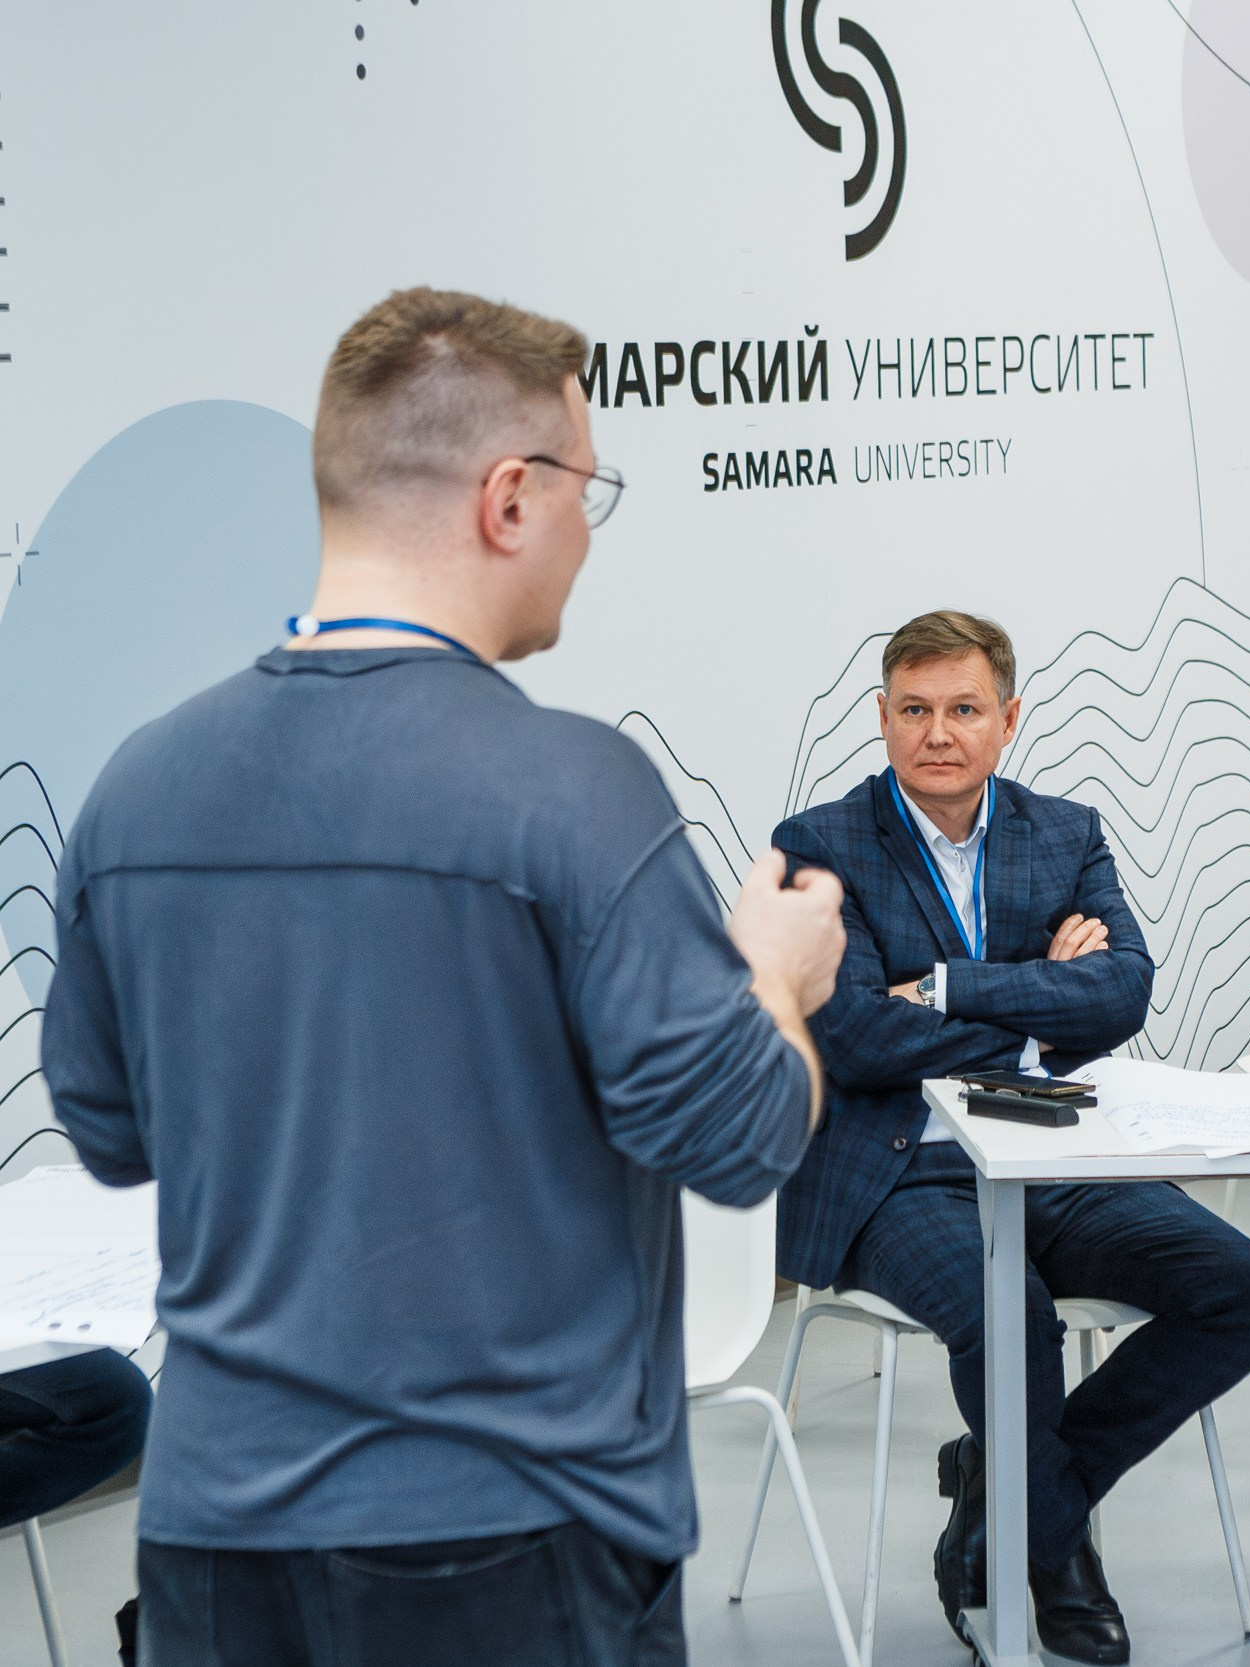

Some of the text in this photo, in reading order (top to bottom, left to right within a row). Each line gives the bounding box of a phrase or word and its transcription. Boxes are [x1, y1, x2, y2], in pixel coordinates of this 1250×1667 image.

[578, 324, 1155, 409] МАРСКИЙ УНИВЕРСИТЕТ
[702, 437, 1013, 492] SAMARA UNIVERSITY
